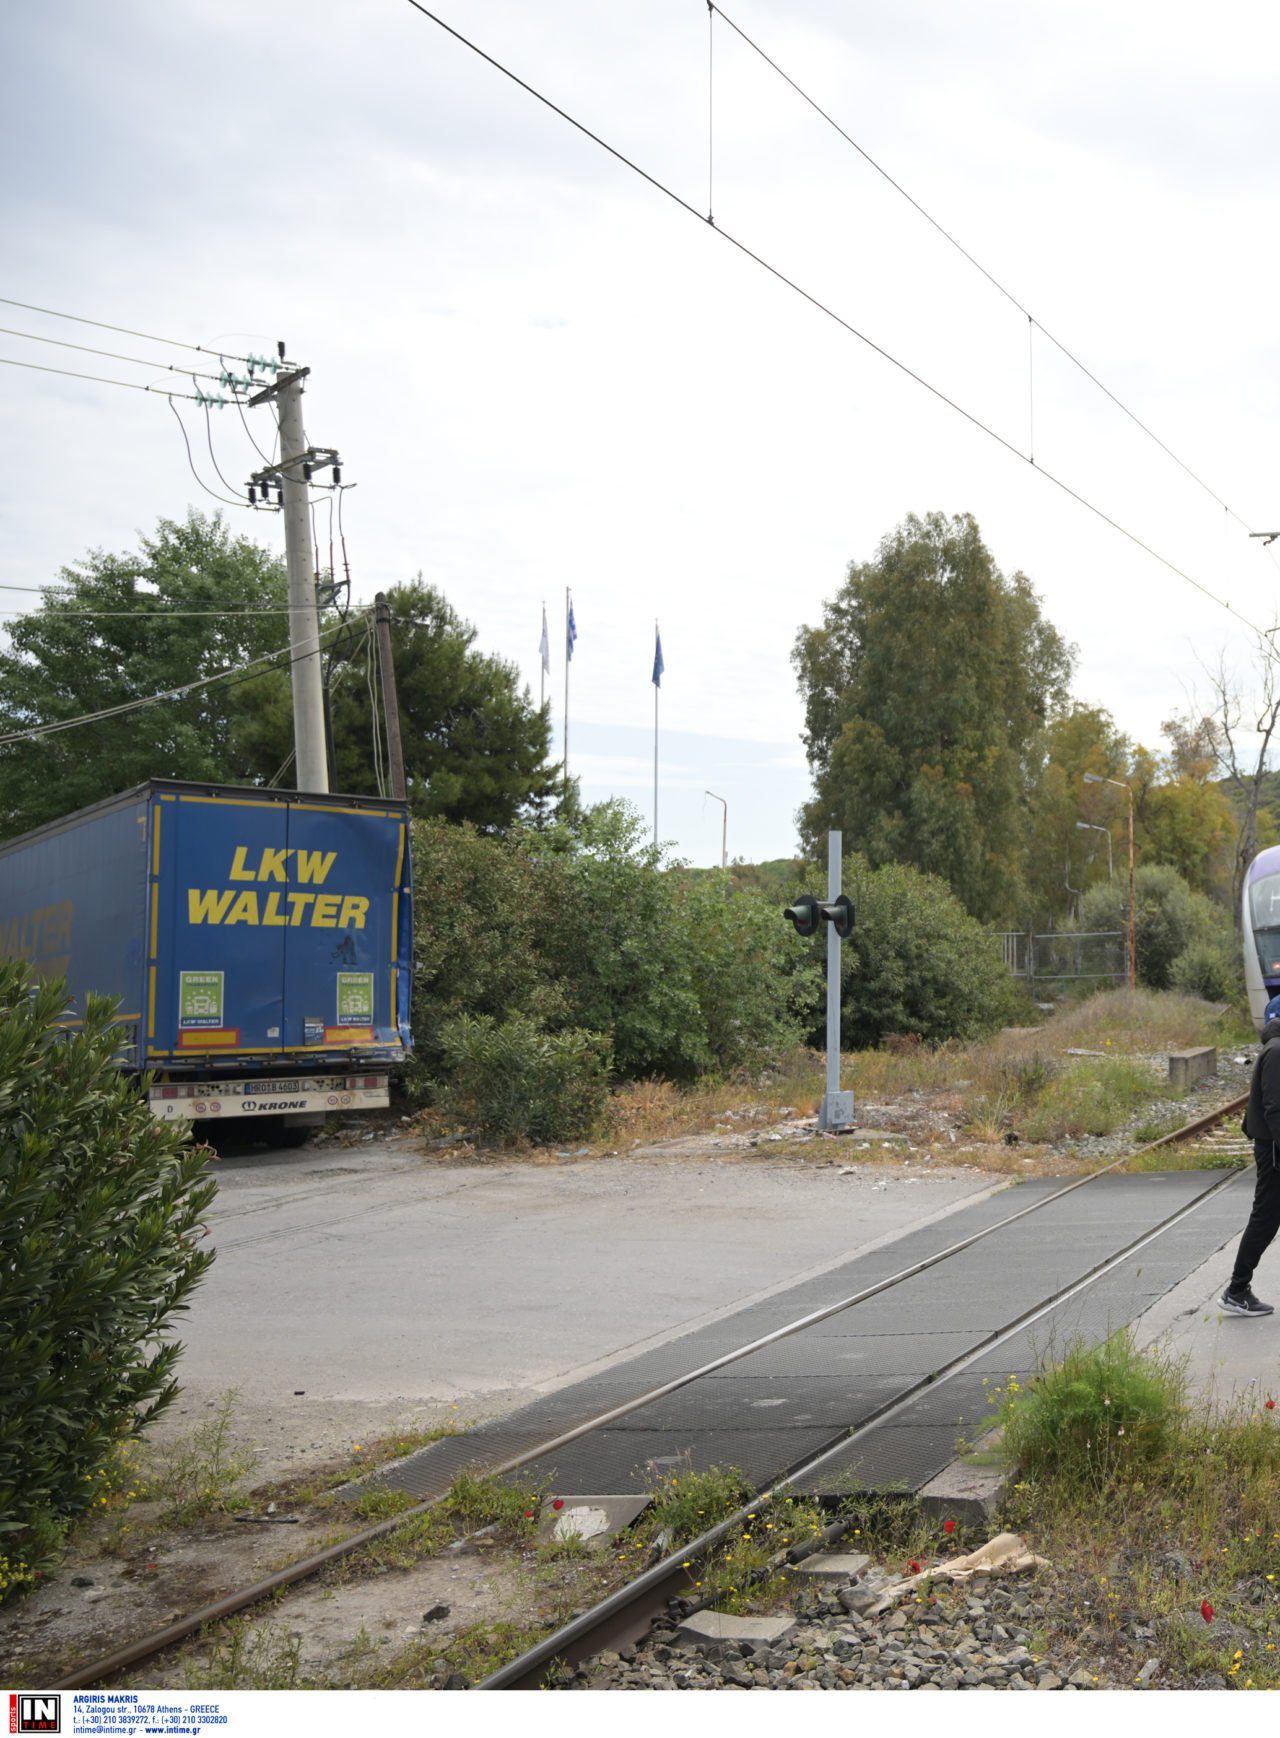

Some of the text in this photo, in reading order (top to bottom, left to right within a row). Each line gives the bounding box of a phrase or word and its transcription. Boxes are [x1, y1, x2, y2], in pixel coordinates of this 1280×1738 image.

[229, 846, 337, 885] LKW
[188, 888, 370, 929] WALTER
[278, 1082, 298, 1091] 4603
[167, 1105, 174, 1113] D
[258, 1100, 308, 1111] KRONE
